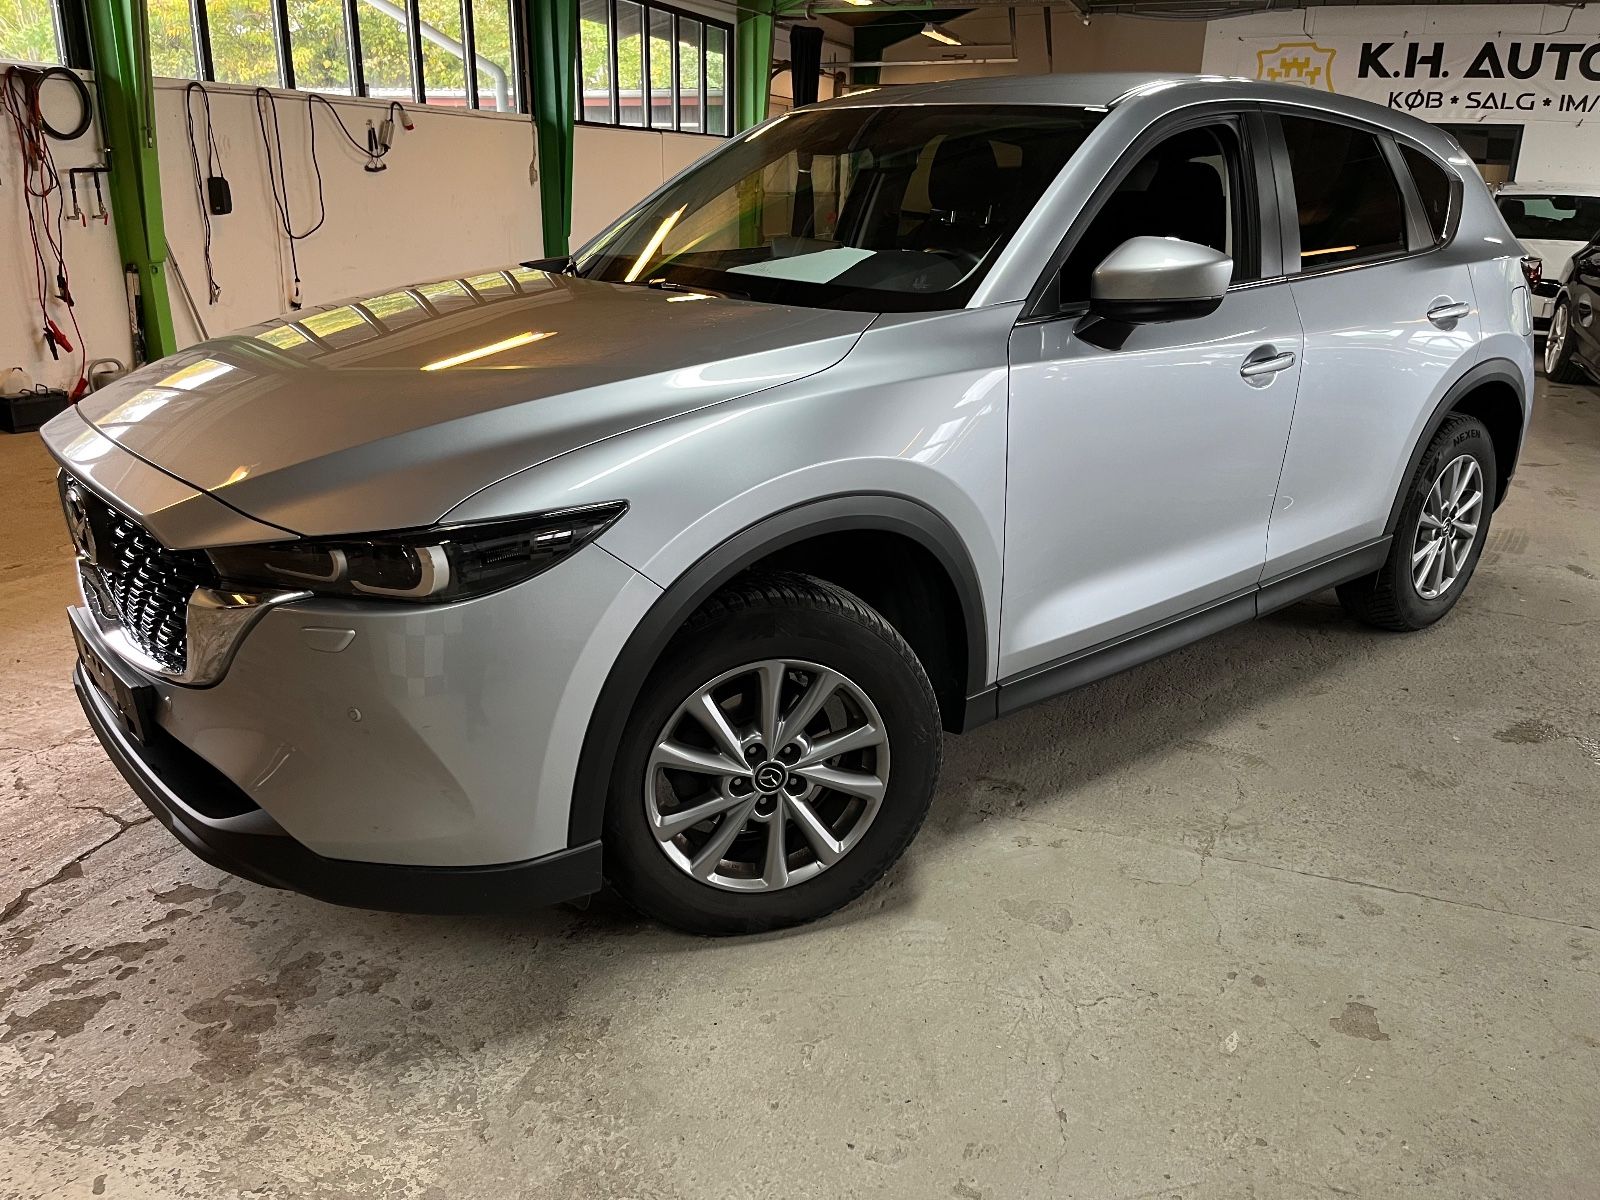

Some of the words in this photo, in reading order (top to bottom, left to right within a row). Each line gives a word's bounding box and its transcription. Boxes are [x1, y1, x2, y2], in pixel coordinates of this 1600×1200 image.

[1358, 42, 1449, 78] K.H.
[1388, 89, 1444, 111] KØB
[1465, 91, 1535, 110] SALG
[1453, 429, 1481, 447] NEXEN
